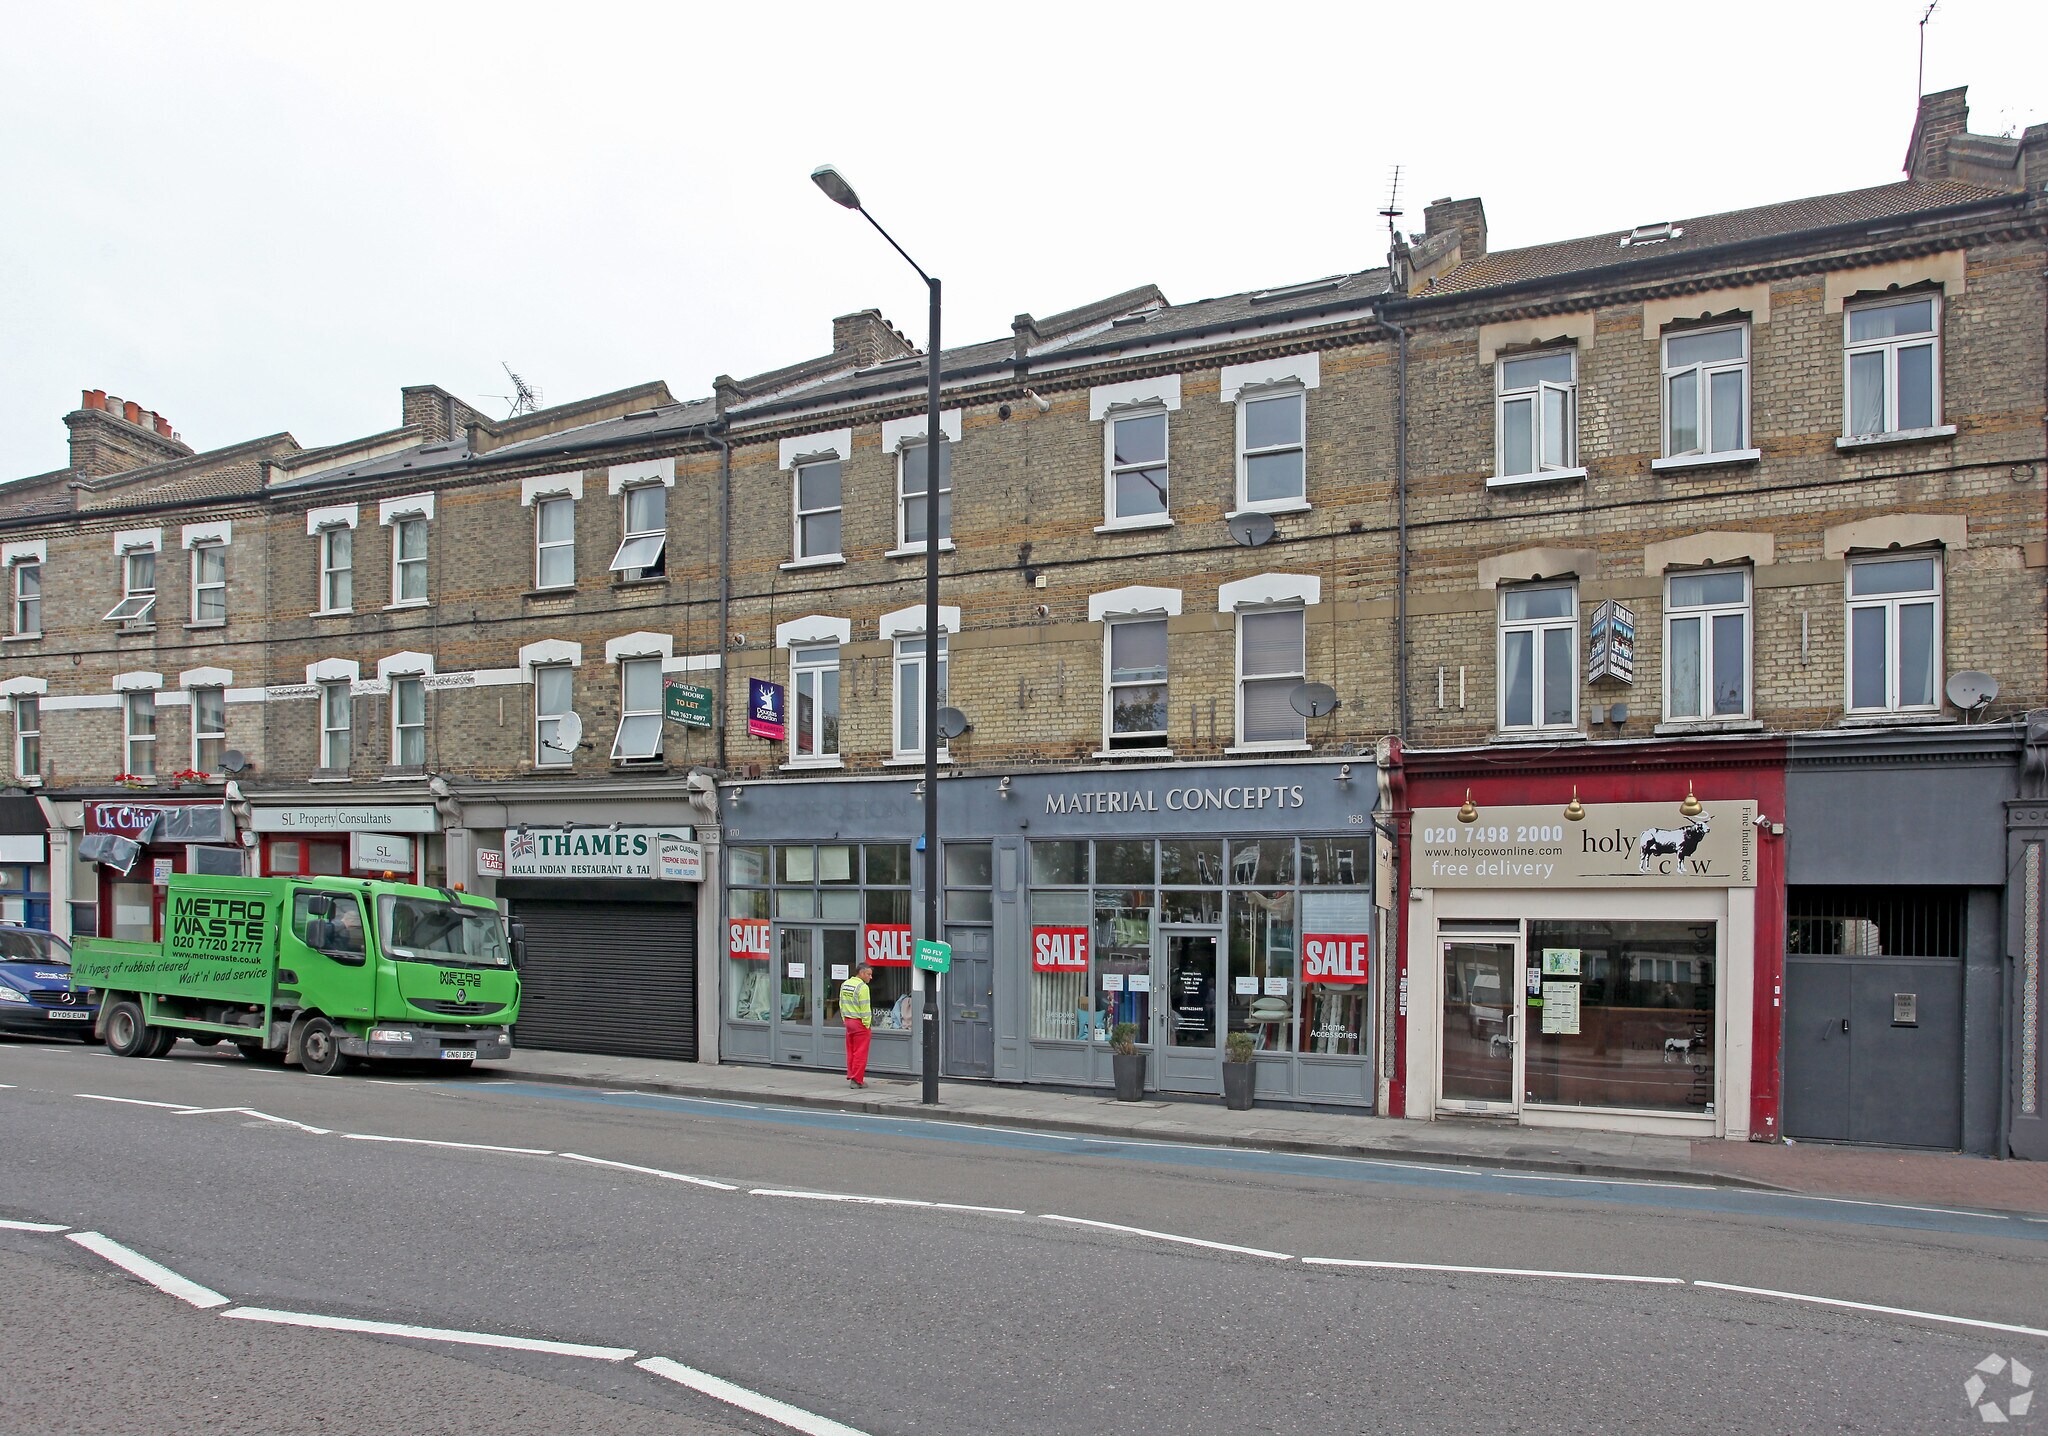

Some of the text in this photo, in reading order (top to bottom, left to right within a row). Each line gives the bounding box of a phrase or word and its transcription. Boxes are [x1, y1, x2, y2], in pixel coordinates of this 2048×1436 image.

[671, 682, 698, 692] AUDSLEY
[682, 690, 705, 700] MOORE
[675, 698, 699, 709] TO LET
[756, 707, 777, 718] Douglas
[1045, 785, 1304, 814] MATERIAL CONCEPTS
[282, 812, 392, 827] SL Property Consultants
[1347, 815, 1363, 824] 168
[729, 829, 740, 837] 170
[1424, 825, 1563, 844] 020 7498 2000
[538, 833, 648, 856] THAMES
[661, 845, 679, 854] INDIAN
[1581, 828, 1637, 860] holy
[1741, 807, 1752, 882] Fine Indian Food
[376, 845, 391, 857] SL
[481, 852, 499, 861] JUST
[1424, 846, 1563, 858] www.holycowonline.com
[358, 856, 409, 866] Property Consultants
[486, 861, 499, 869] EAT
[512, 865, 536, 874] HALAL
[539, 865, 567, 874] INDIAN
[571, 865, 622, 875] RESTAURANT
[626, 865, 633, 874] &
[1432, 860, 1554, 879] free delivery
[175, 897, 265, 920] METRO
[174, 917, 264, 941] WASTE
[172, 936, 263, 954] 020 7720 2777
[730, 924, 770, 954] SALE
[867, 930, 911, 961] SALE
[1035, 933, 1086, 967] SALE
[172, 950, 262, 965] www.metrowaste.co.uk
[920, 953, 943, 964] TIPPING
[1306, 940, 1365, 977] SALE
[76, 959, 190, 976] All types of rubbish cleared
[212, 968, 232, 982] load
[233, 968, 268, 980] service
[440, 970, 481, 981] METRO
[440, 979, 481, 987] WASTE
[1321, 1022, 1346, 1031] Home
[1310, 1029, 1358, 1040] Accessories
[446, 1051, 475, 1059] GN61 BPE
